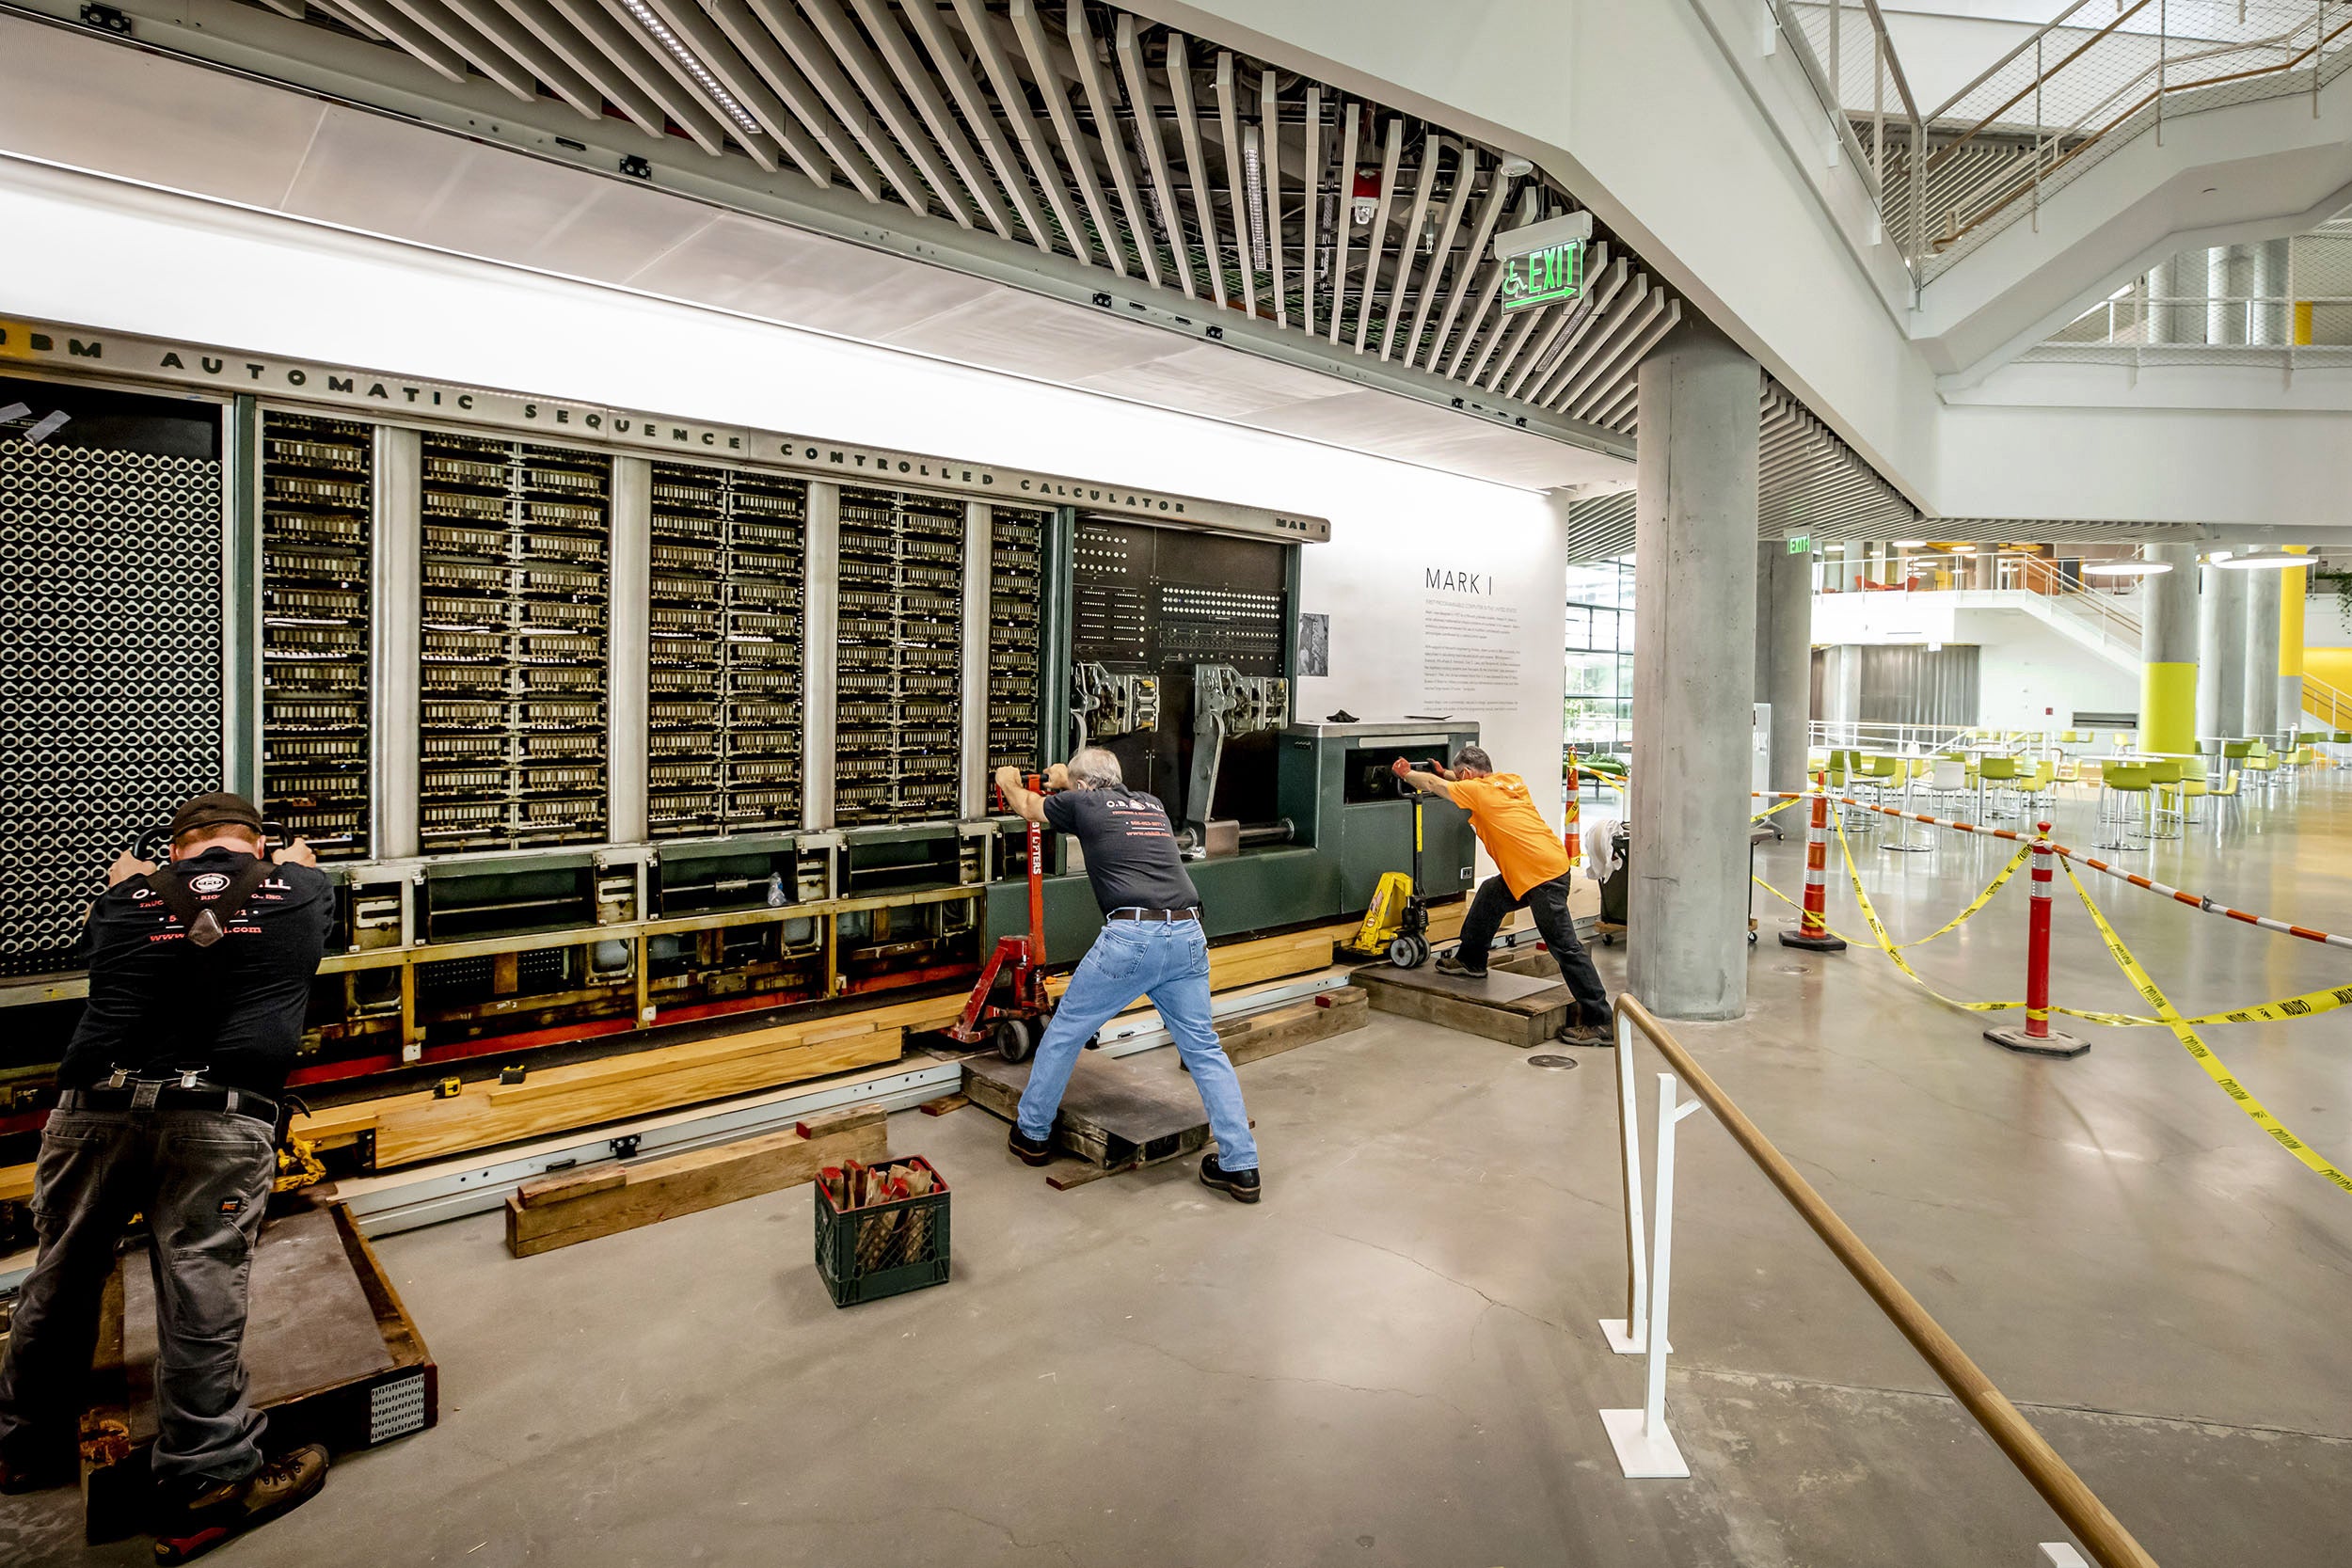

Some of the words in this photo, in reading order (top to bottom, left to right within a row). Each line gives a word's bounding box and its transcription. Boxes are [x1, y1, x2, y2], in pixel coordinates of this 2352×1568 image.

[1529, 243, 1578, 293] EXIT
[160, 352, 474, 410] AUTOMATIC
[525, 404, 740, 449] SEQUENCE
[781, 443, 993, 485] CONTROLLED
[1021, 479, 1185, 513] CALCULATOR
[1790, 536, 1807, 554] EXIT
[1425, 567, 1480, 594] MARK
[1488, 576, 1492, 595] I
